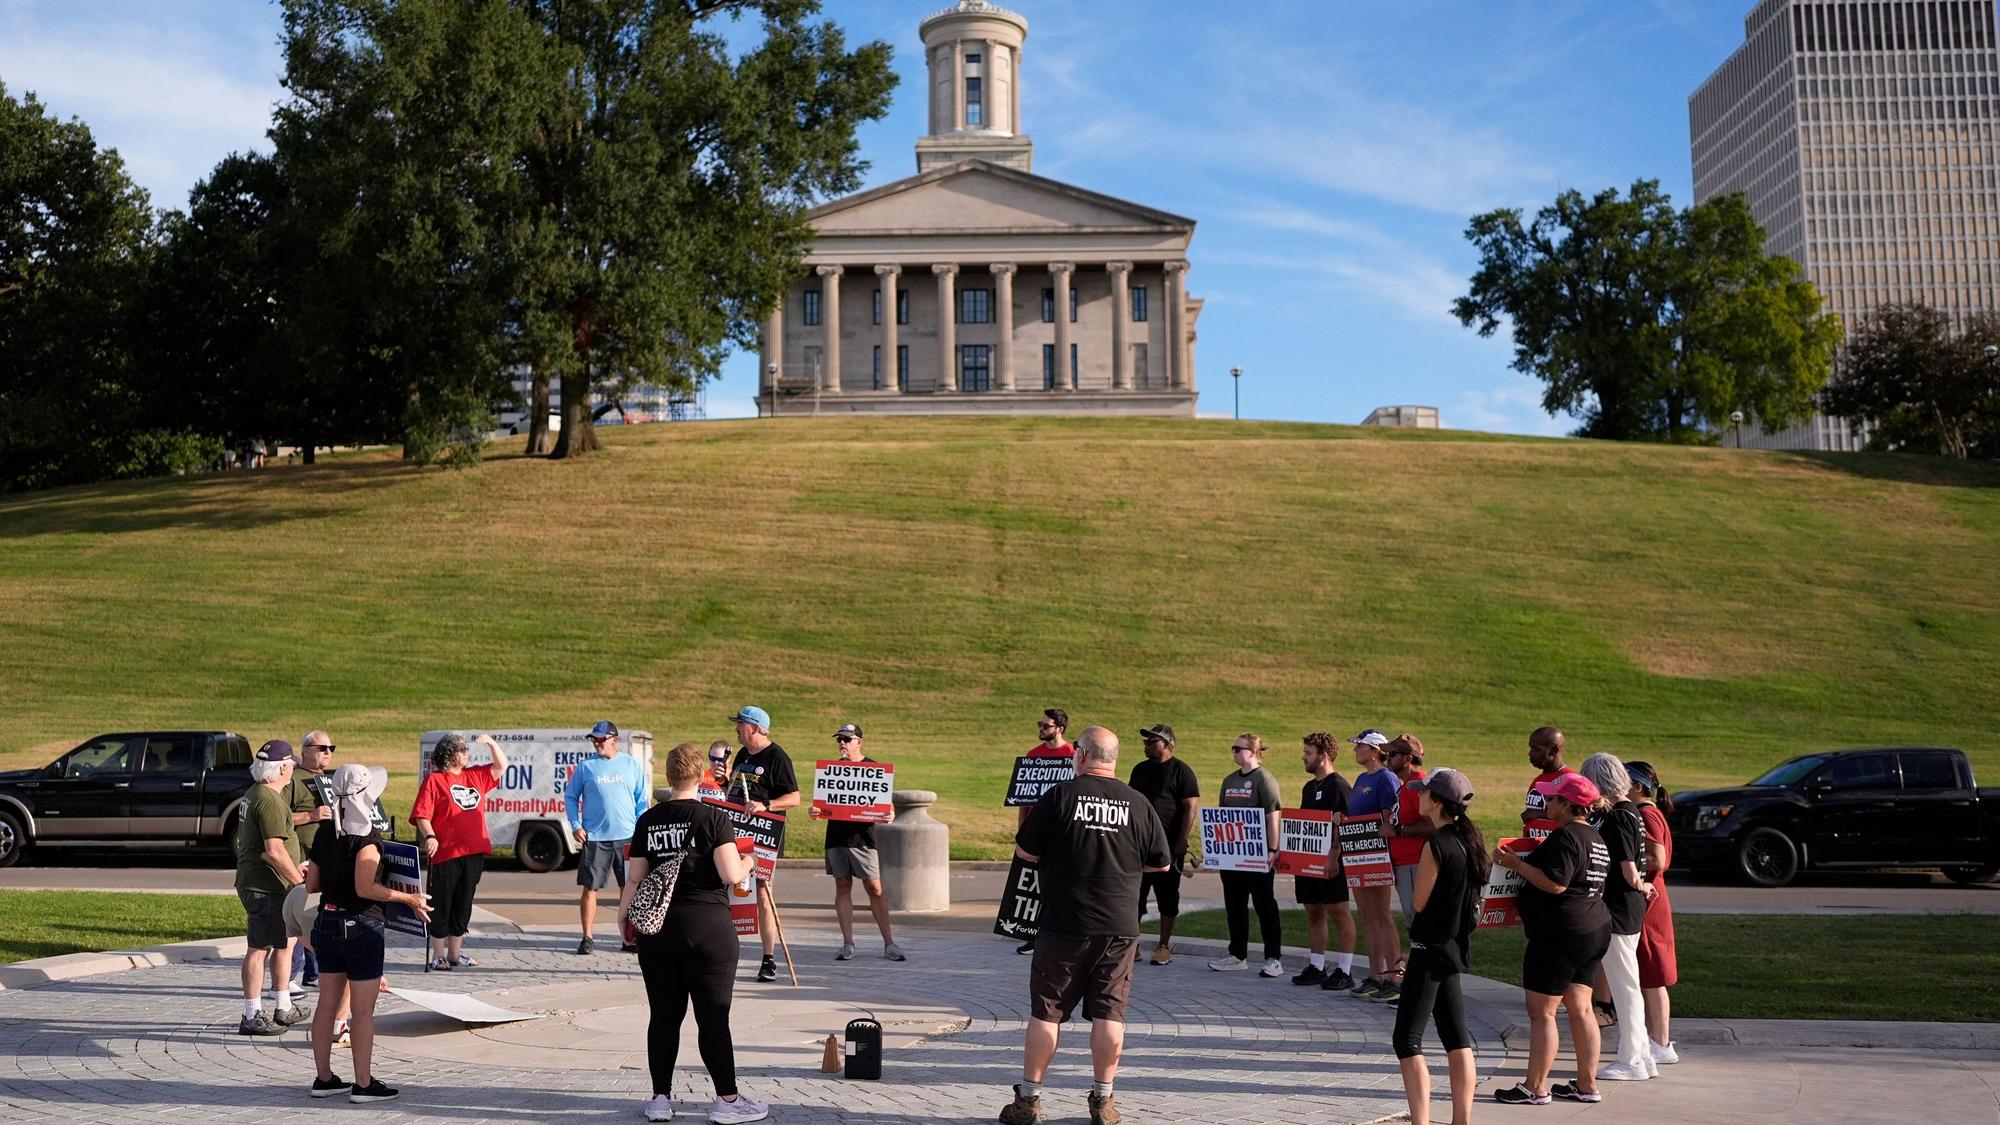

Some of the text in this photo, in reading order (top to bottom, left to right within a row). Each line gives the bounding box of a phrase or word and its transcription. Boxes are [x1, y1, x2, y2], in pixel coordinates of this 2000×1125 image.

[1035, 758, 1063, 766] Oppose
[554, 767, 565, 779] IS
[824, 766, 884, 779] JUSTICE
[1016, 767, 1076, 781] EXECUTION
[817, 779, 889, 793] REQUIRES
[1014, 782, 1039, 796] THIS
[827, 793, 877, 806] MERCY
[1078, 795, 1130, 807] DEATH PENALTY
[1073, 801, 1130, 827] ACTION
[1202, 808, 1261, 825] EXECUTION
[668, 822, 692, 830] PENALT
[750, 815, 773, 831] ARE
[1283, 820, 1329, 837] THOU SHALT
[1339, 822, 1378, 836] BLESSED ARE
[733, 827, 777, 847] ERCIFUL
[1204, 822, 1263, 842] IS NOT THE
[1205, 840, 1264, 857] SOLUTION
[1287, 836, 1322, 853] NOT KILL!
[1341, 837, 1387, 852] THE MERCIFUL
[1489, 885, 1505, 896] THE
